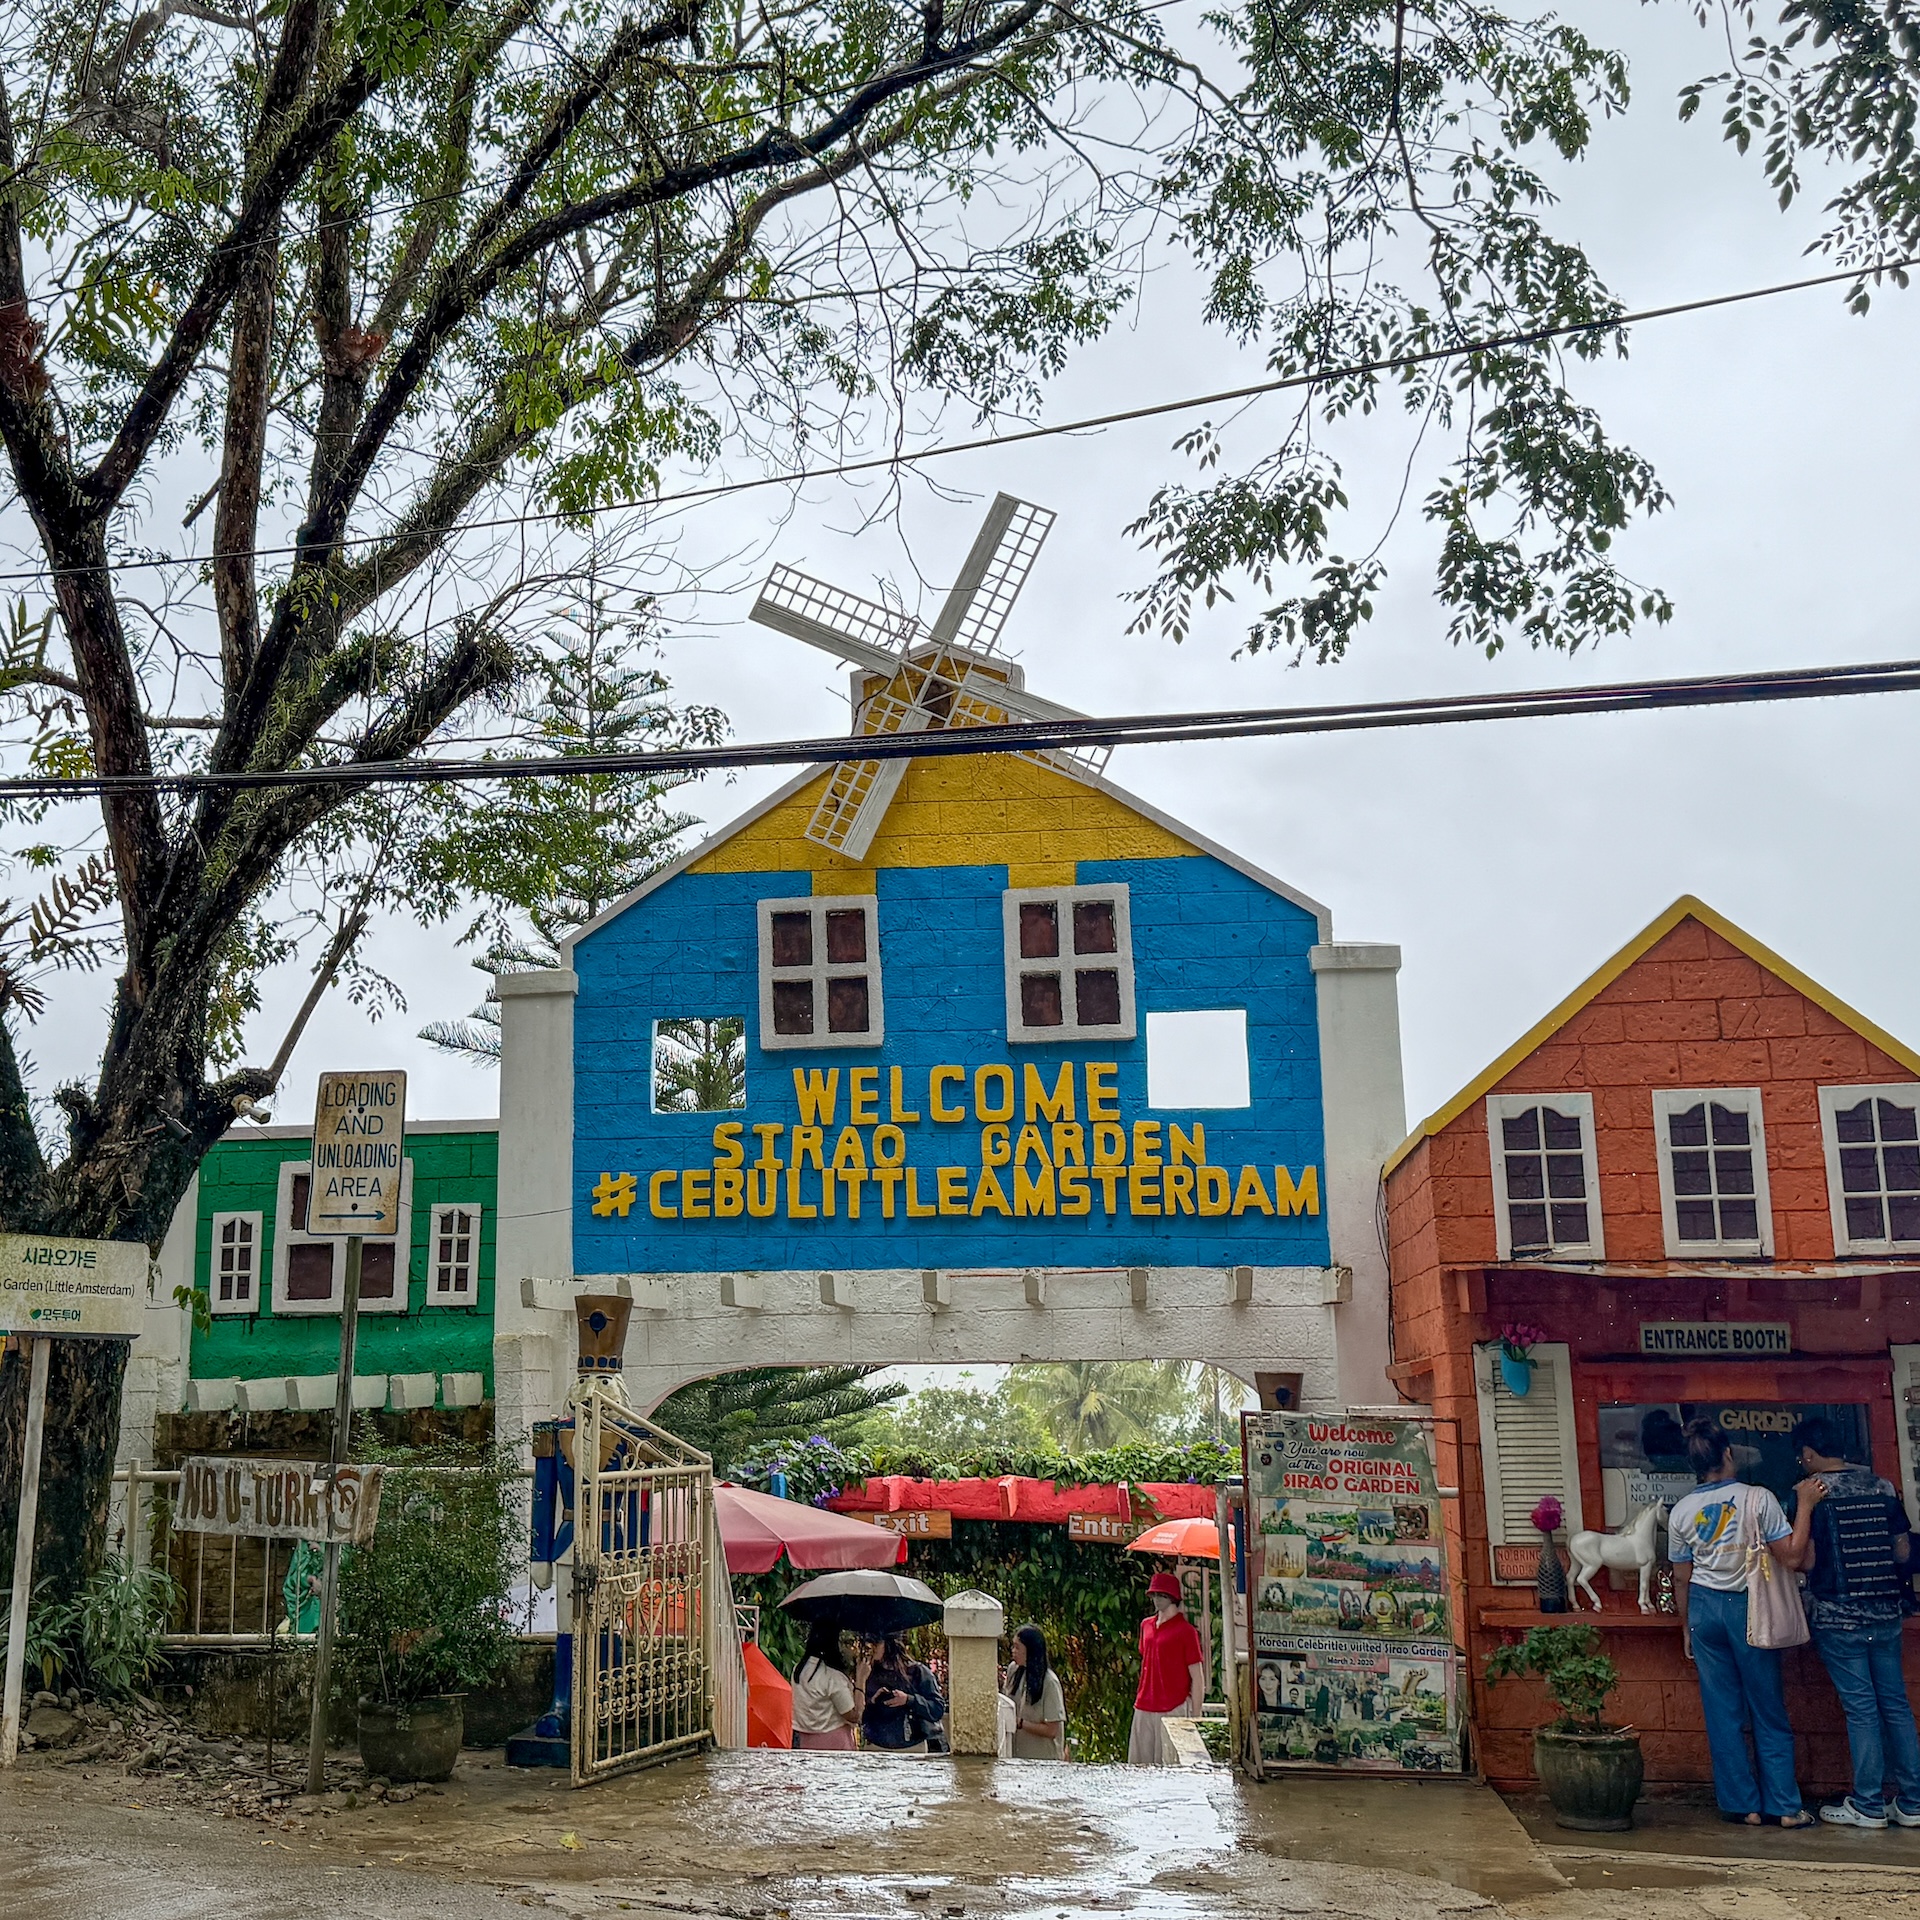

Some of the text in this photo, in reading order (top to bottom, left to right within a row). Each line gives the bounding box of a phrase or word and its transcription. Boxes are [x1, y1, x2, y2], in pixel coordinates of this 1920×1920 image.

[324, 1082, 396, 1107] LOADING
[792, 1062, 1120, 1126] WELCOME
[334, 1115, 384, 1135] AND
[713, 1120, 1206, 1170] SIRAO GARDEN
[317, 1143, 398, 1168] UNLOADING
[325, 1177, 382, 1197] AREA
[22, 1247, 97, 1269] 시라오가든
[3, 1278, 135, 1297] Garden (Little Amsterdam)
[42, 1308, 81, 1321] 모두투어
[1644, 1329, 1787, 1349] ENTRANCE BOOTH
[1719, 1408, 1803, 1432] GARDEN
[1308, 1423, 1396, 1445] Welcome
[1283, 1441, 1368, 1458] You are now
[1288, 1460, 1301, 1469] at
[1329, 1459, 1418, 1477] ORIGINAL
[1283, 1474, 1420, 1494] SIRAO GARDEN
[1631, 1483, 1664, 1492] NO ID
[181, 1465, 318, 1528] NO U-TURN
[1631, 1494, 1646, 1502] NO
[873, 1512, 930, 1533] Exit
[1497, 1549, 1510, 1561] NO
[1501, 1564, 1525, 1576] FOOD
[1259, 1637, 1449, 1658] Korean Celebrities visited Sirao Garden
[1327, 1656, 1349, 1666] March
